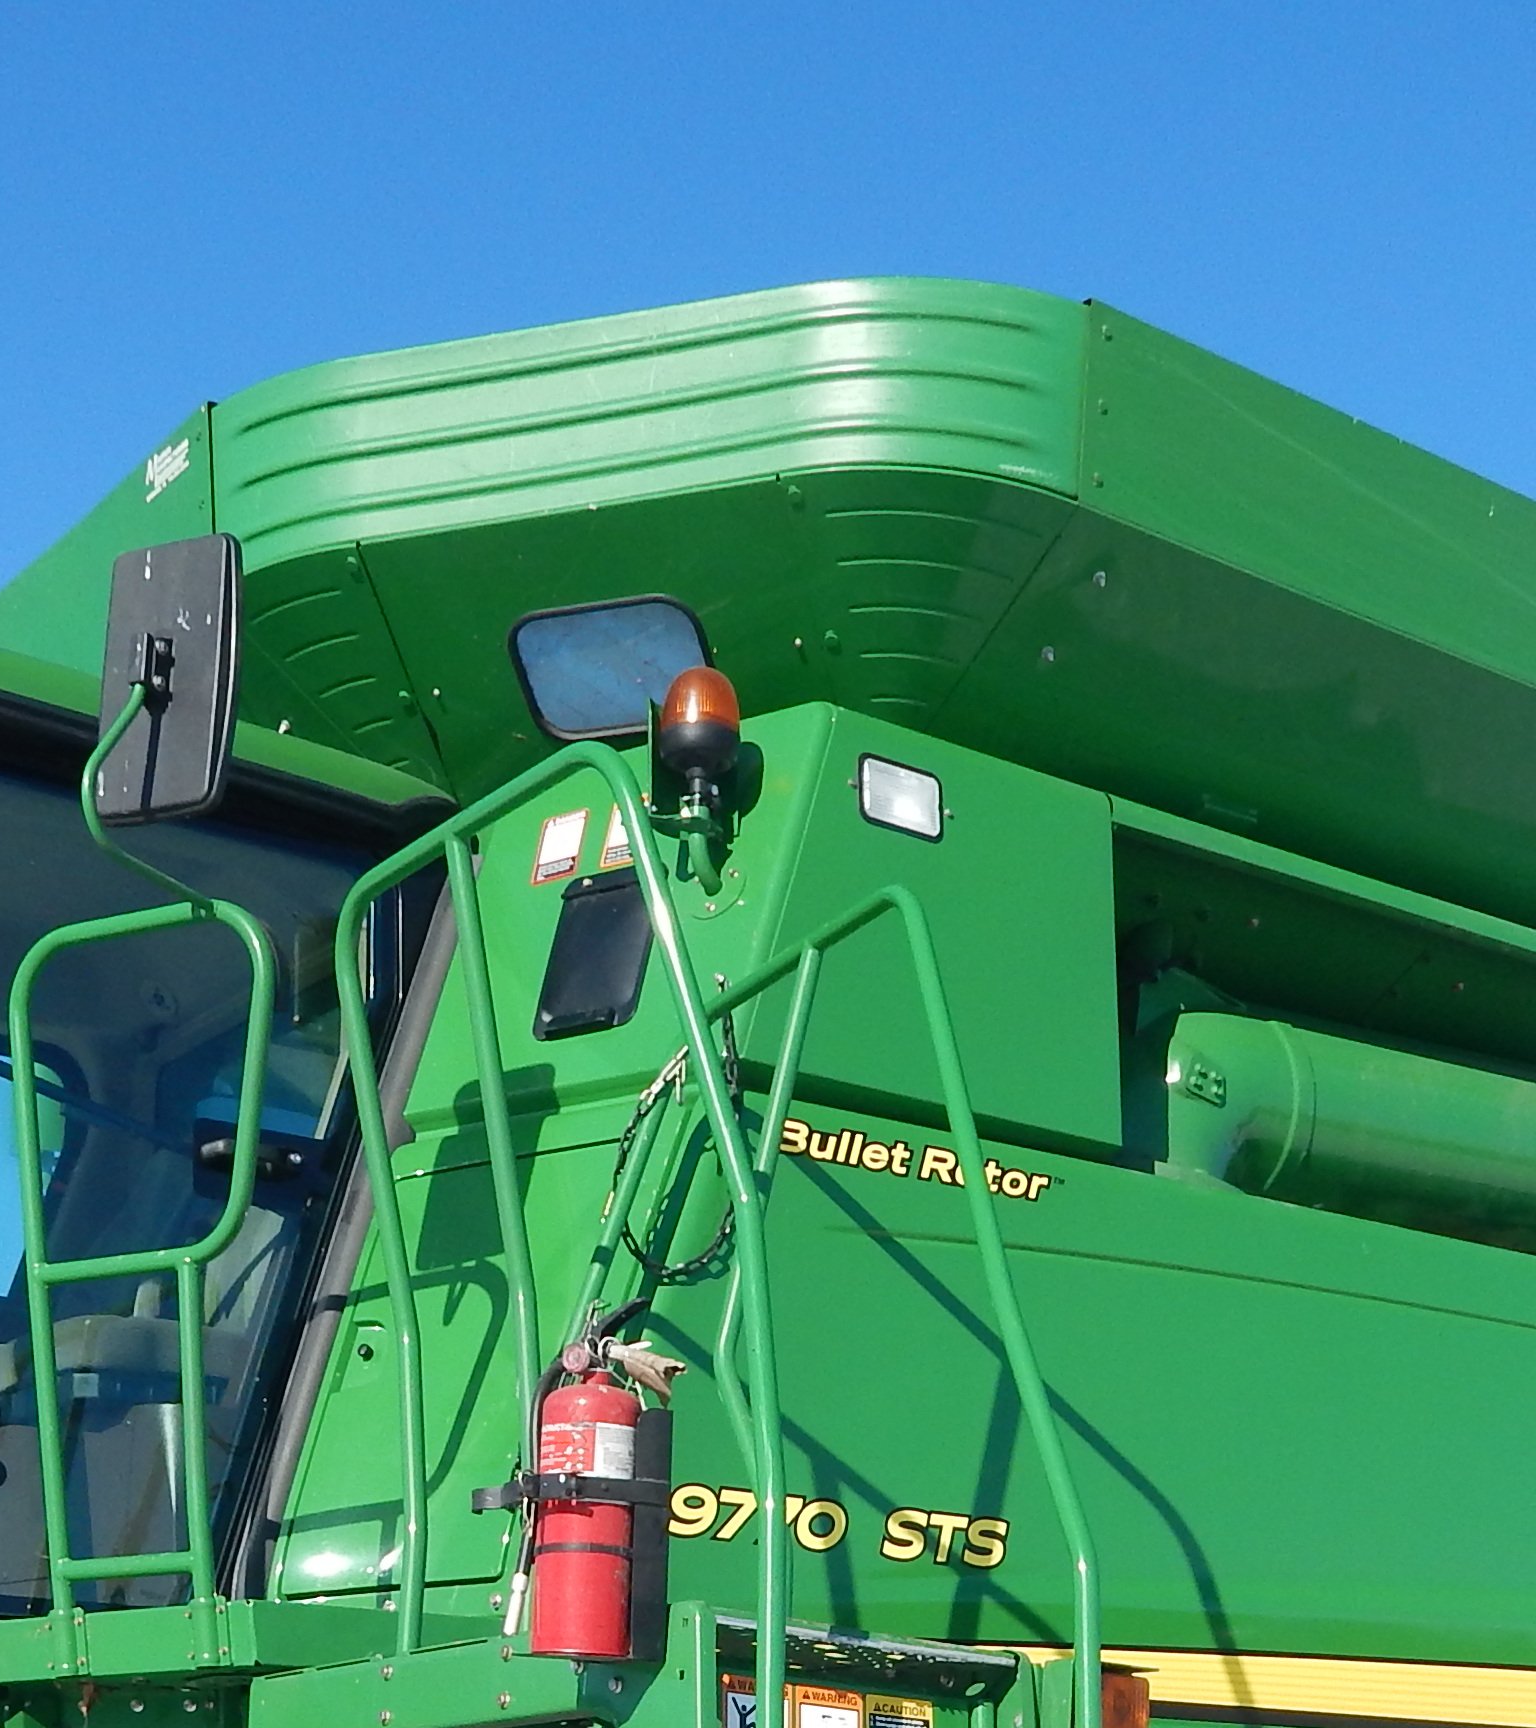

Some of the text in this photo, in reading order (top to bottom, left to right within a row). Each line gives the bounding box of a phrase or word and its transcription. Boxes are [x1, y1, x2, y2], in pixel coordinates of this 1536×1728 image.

[780, 1119, 913, 1176] Bullet
[880, 1507, 1010, 1568] STS
[882, 1703, 926, 1717] CAUTION
